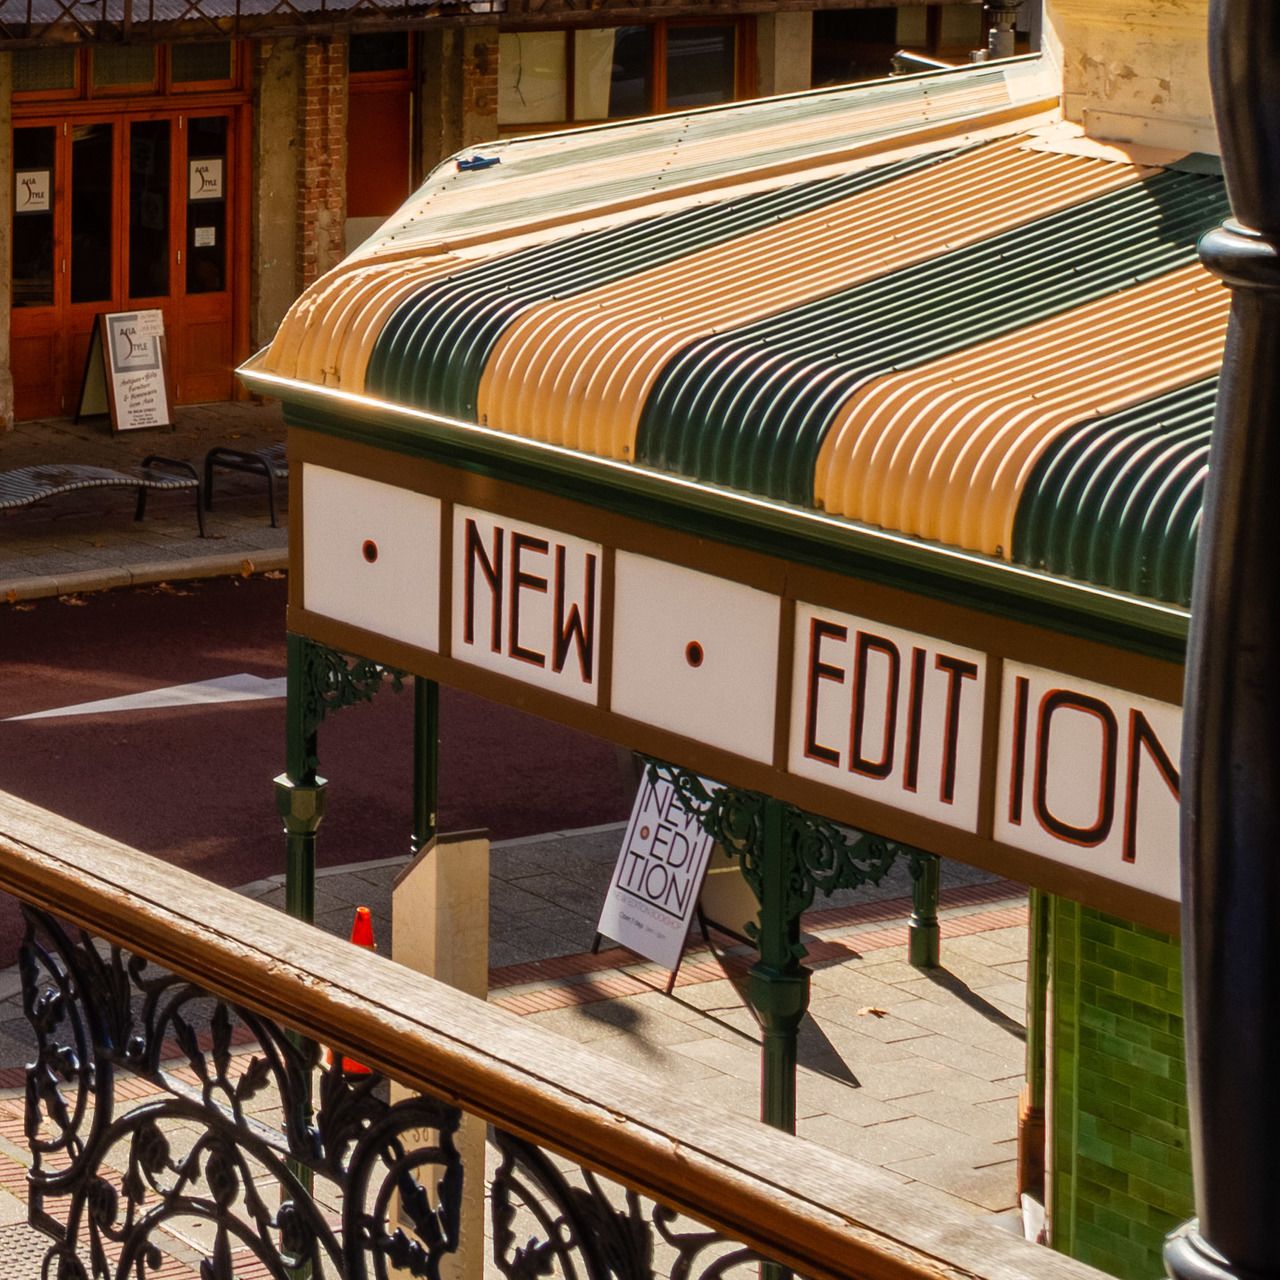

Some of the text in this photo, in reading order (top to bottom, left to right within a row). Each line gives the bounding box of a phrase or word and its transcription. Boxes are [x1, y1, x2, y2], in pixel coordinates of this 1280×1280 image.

[464, 517, 1181, 865] NEW EDITION
[649, 822, 698, 874] EDI
[629, 849, 690, 913] TION
